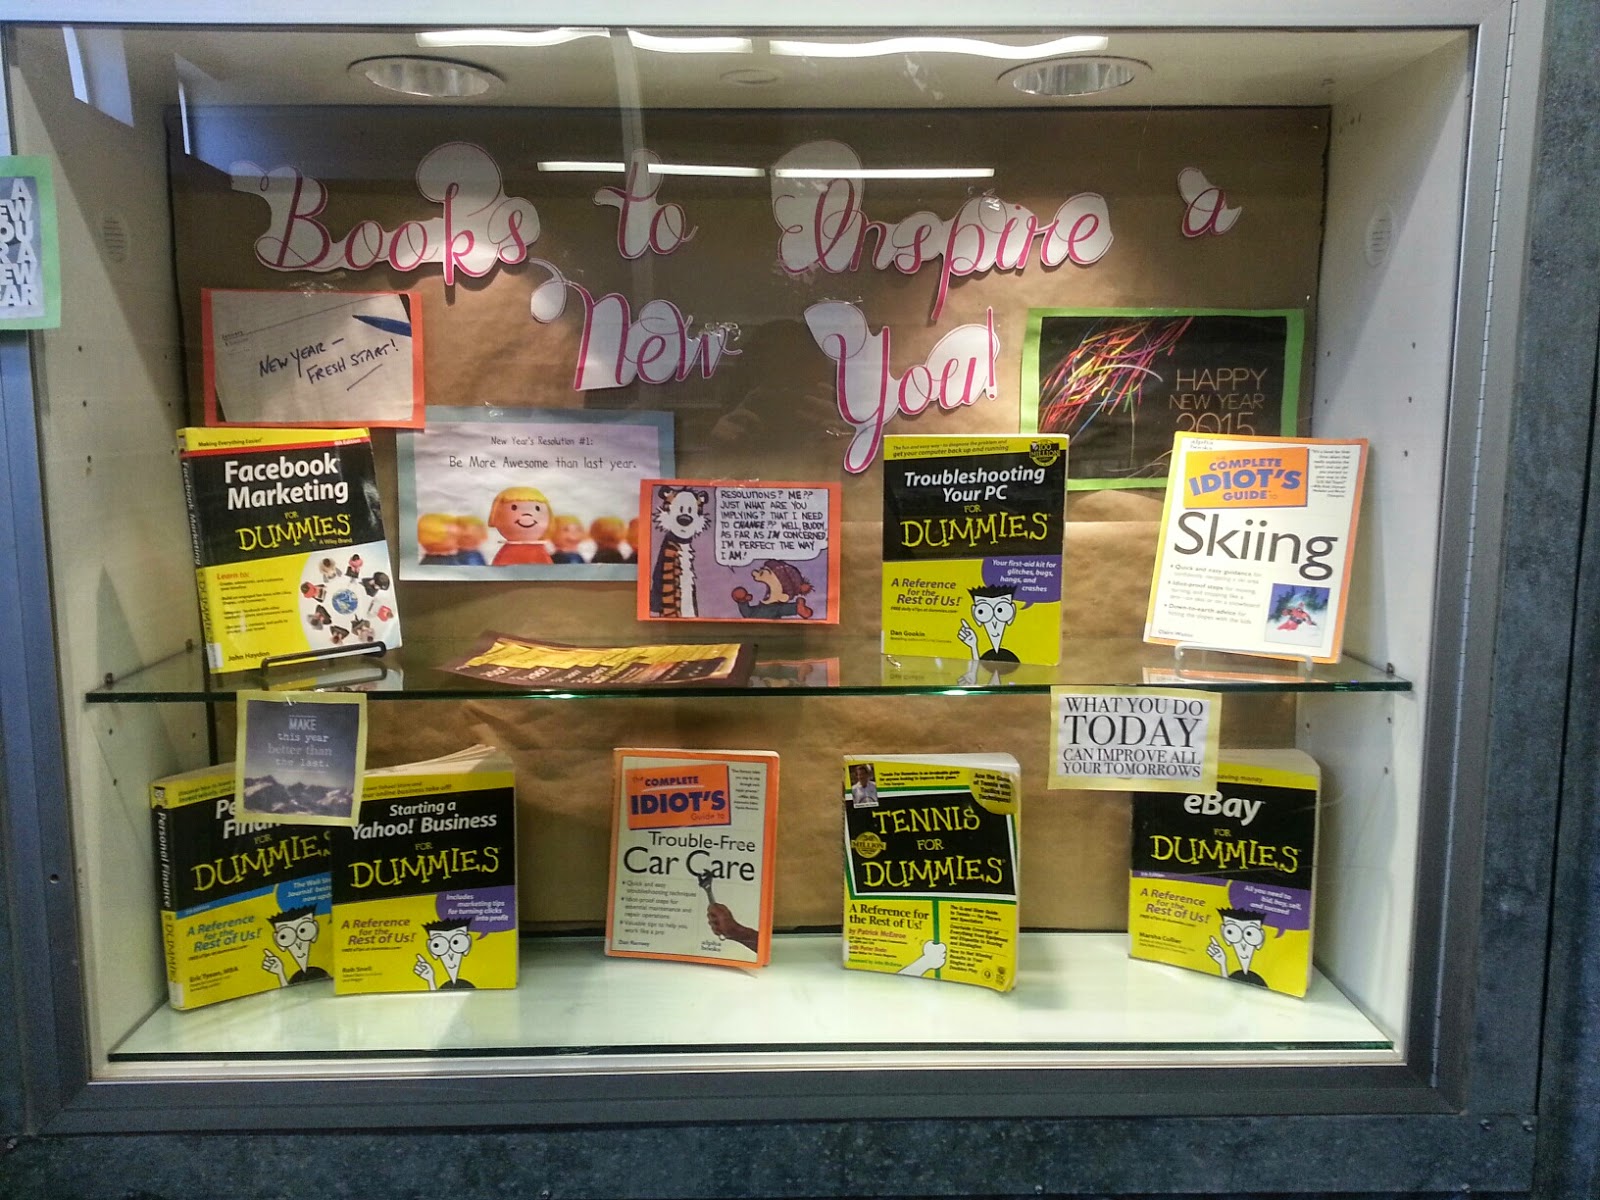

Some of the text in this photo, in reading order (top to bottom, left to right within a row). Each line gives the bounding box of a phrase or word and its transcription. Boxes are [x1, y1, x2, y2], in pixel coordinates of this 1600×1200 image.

[232, 143, 1242, 321] Books to Inspire a
[259, 342, 326, 378] NEW YEAR
[307, 339, 398, 384] FRESH START!
[531, 258, 999, 474] New You!
[1176, 368, 1267, 391] HAPPY
[1169, 393, 1265, 410] NEW YEAR
[1176, 412, 1255, 435] 2015
[491, 436, 593, 446] New Year's Resolution #1:
[225, 453, 339, 484] Facebook
[449, 455, 637, 471] Be More Awesome than last year.
[1209, 458, 1282, 471] COMPLETE
[905, 465, 1046, 487] Troubleshooting
[1188, 468, 1303, 497] IDIOT'S
[227, 479, 348, 510] Marketing
[721, 490, 813, 499] RESOLUTIONS? ME??
[943, 485, 1008, 502] Your PC
[1222, 490, 1269, 501] GUIDE
[182, 461, 195, 511] Facebook
[189, 513, 202, 565] Marketing
[964, 505, 982, 513] FOR
[235, 513, 351, 551] DUMMIES
[767, 531, 780, 539] I'M
[900, 512, 1049, 548] DUMMIES
[739, 542, 776, 550] PERFECT
[780, 542, 794, 550] THE
[798, 542, 815, 550] WAY
[1173, 511, 1339, 581] Skiing
[729, 552, 748, 560] AM!
[992, 559, 1007, 567] Your
[1000, 576, 1022, 584] hangs,
[1035, 569, 1053, 577] bugs,
[891, 578, 956, 590] A Reference
[897, 594, 961, 607] Rest of Us!
[1065, 697, 1203, 716] WHAT YOU DO
[289, 718, 316, 731] MAKE
[1064, 715, 1203, 748] TODAY
[278, 732, 330, 743] this year
[268, 743, 333, 755] better than
[1063, 748, 1200, 765] CAN IMPROVE ALL
[1064, 762, 1200, 778] YOUR TOMORROWS
[645, 776, 698, 787] COMPLETE
[389, 801, 456, 817] Starting a
[630, 790, 726, 815] IDIOT'S
[1184, 791, 1261, 826] eBay
[351, 814, 498, 840] Yahoo! Business
[872, 806, 980, 835] TENNIS
[157, 812, 171, 862] Personal
[254, 834, 272, 844] FOR
[1213, 828, 1231, 837] FOR
[415, 842, 433, 851] FOR
[648, 831, 756, 852] Trouble-Free
[917, 838, 944, 851] FOR
[1150, 835, 1298, 874] DUMMIES
[348, 847, 500, 889] DUMMIES
[623, 846, 755, 881] Car Care
[861, 855, 1003, 888] DUMMIES
[161, 863, 172, 908] Finance
[457, 900, 492, 908] marketing
[849, 904, 929, 919] A Reference for
[341, 918, 410, 929] A Reference
[487, 914, 508, 922] profit
[850, 915, 923, 930] the Rest of Us!
[348, 932, 416, 945] Rest of Us!
